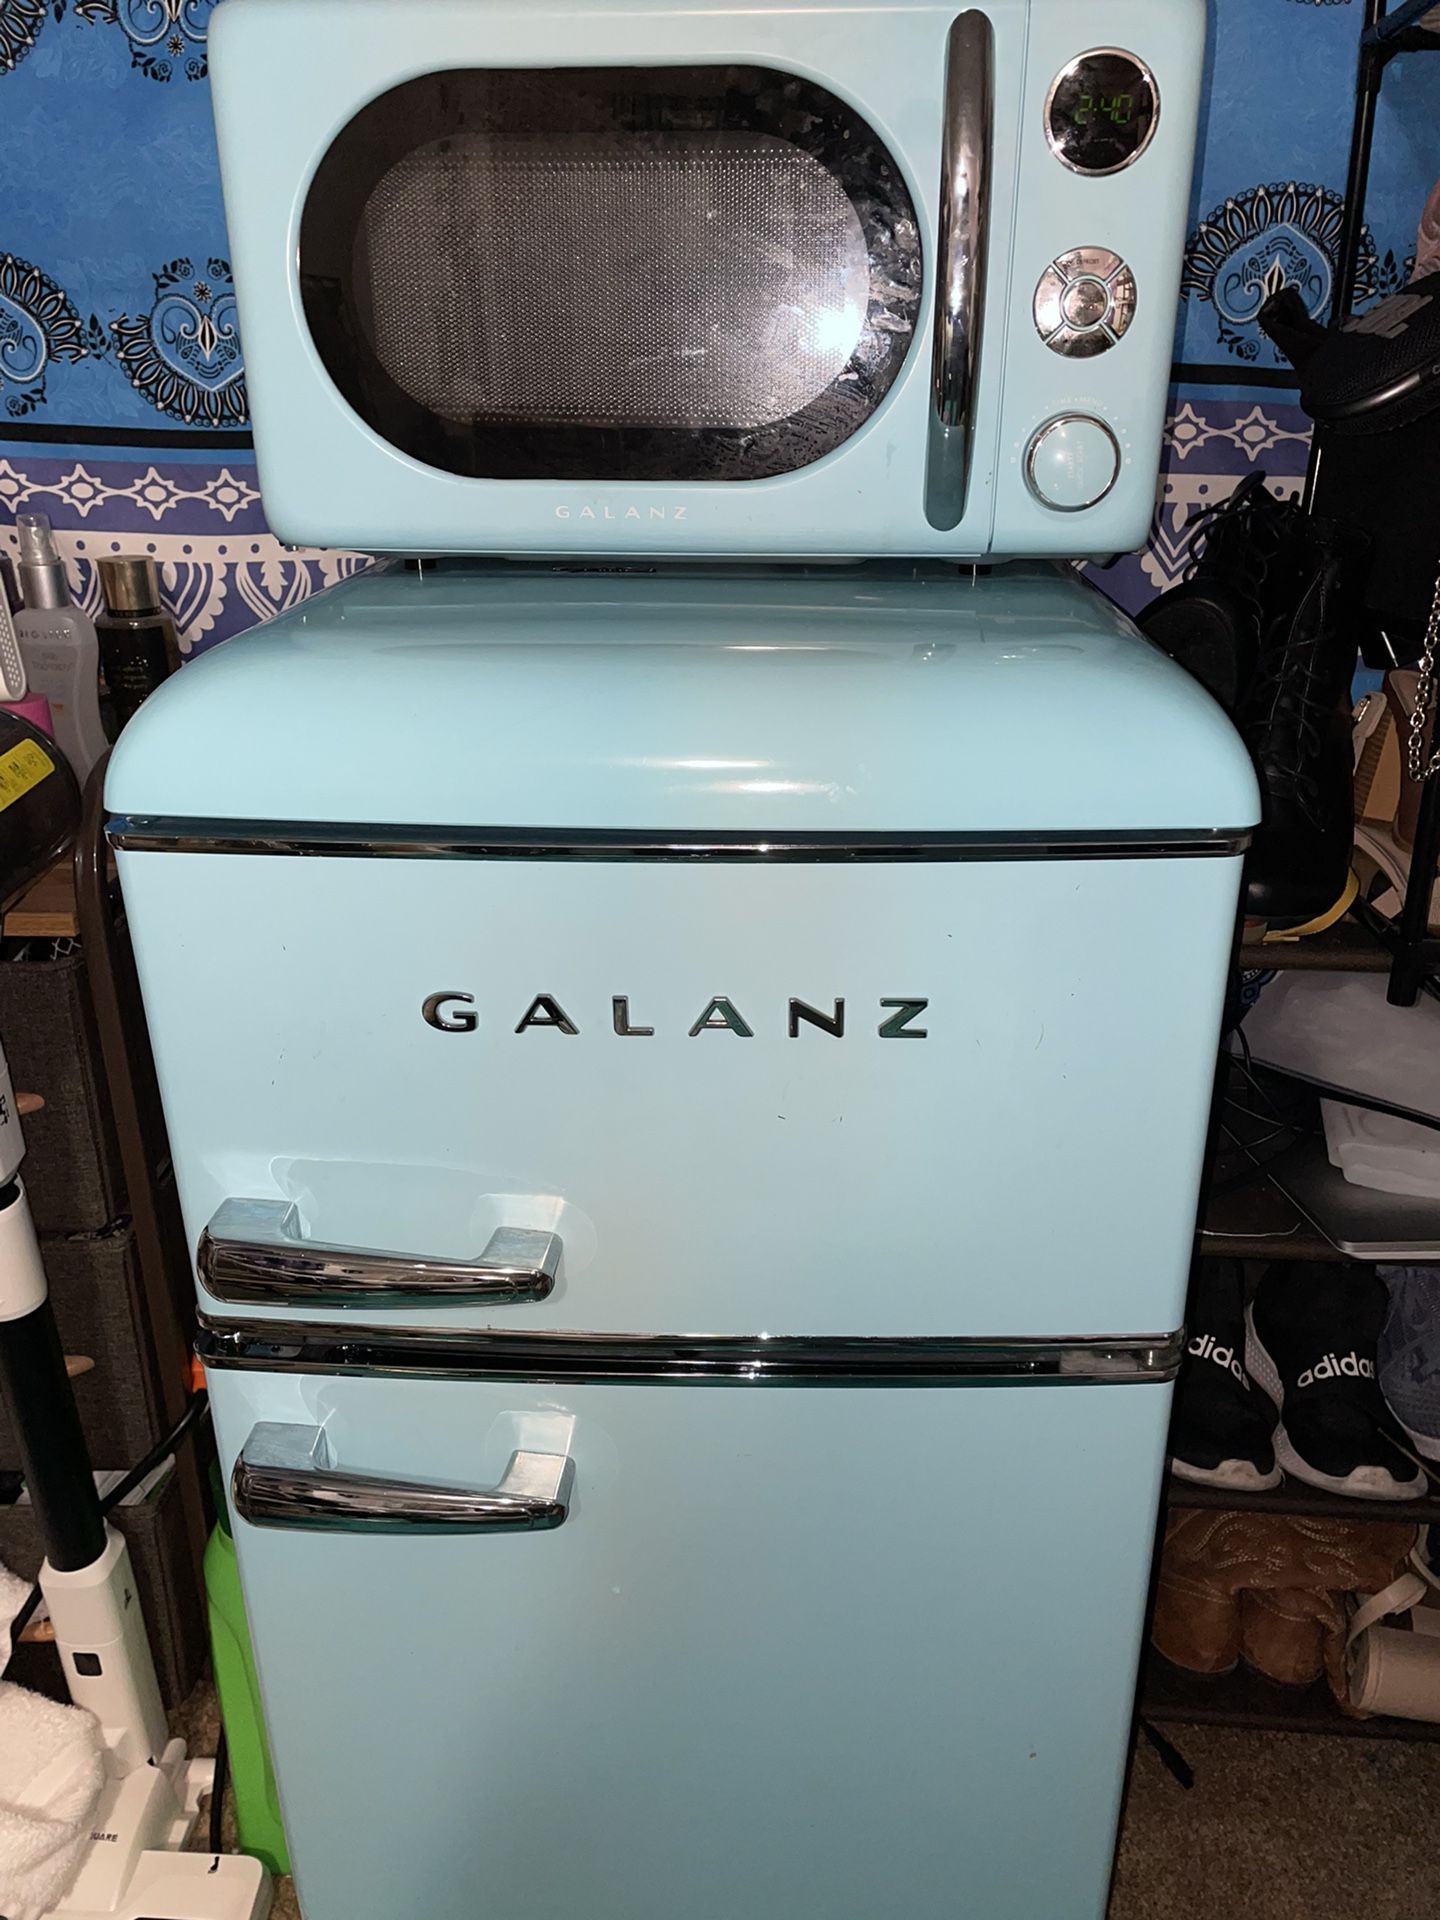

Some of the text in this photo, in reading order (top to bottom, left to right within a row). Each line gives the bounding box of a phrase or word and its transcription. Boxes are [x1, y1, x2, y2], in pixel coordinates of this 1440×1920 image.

[1074, 94, 1132, 124] 2:40
[555, 505, 687, 520] GALANZ
[421, 990, 929, 1038] GALANZ
[1188, 1333, 1250, 1391] didas
[1297, 1351, 1374, 1387] adidas
